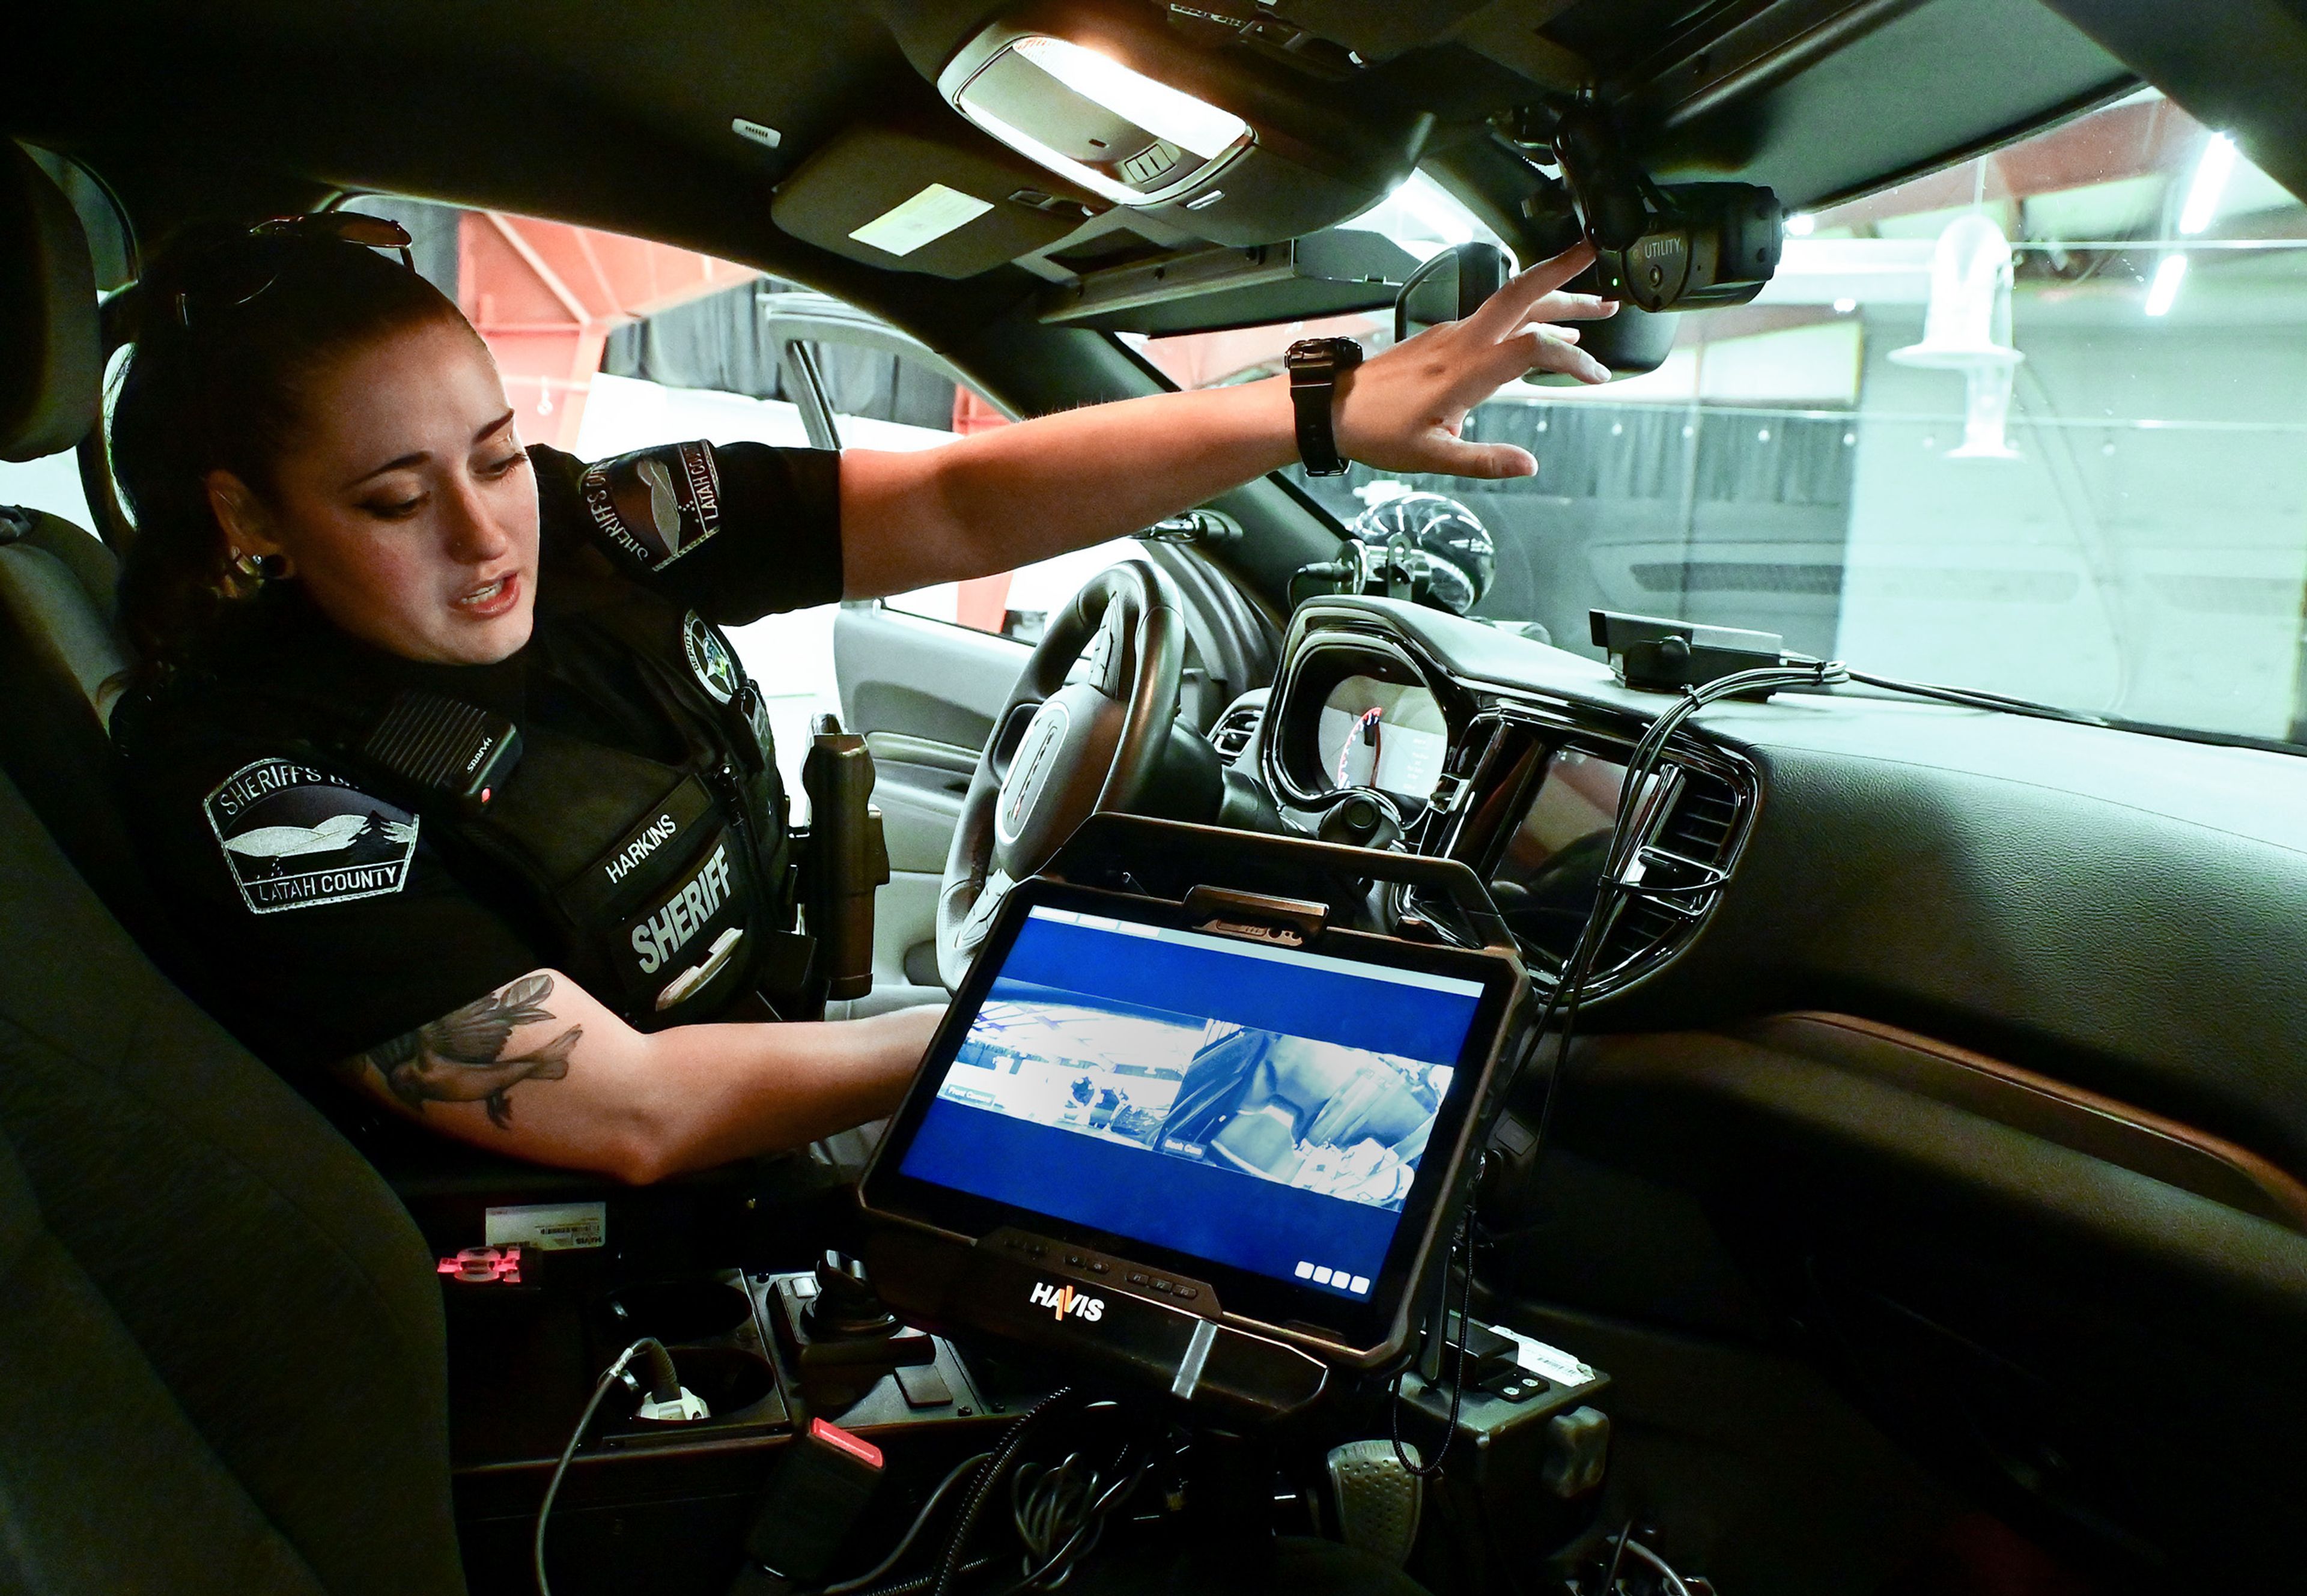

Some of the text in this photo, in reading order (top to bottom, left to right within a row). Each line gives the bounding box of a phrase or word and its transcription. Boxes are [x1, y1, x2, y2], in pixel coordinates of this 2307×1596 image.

[1645, 237, 1681, 259] UTILITY
[693, 475, 719, 520] LATAH
[684, 632, 699, 671] DEPUTY
[467, 736, 493, 774] HARRIS
[606, 813, 677, 884] HARKINS
[260, 866, 397, 902] LATAH COUNTY
[631, 844, 732, 974] SHERIFF
[1030, 1282, 1104, 1323] HAVIS
